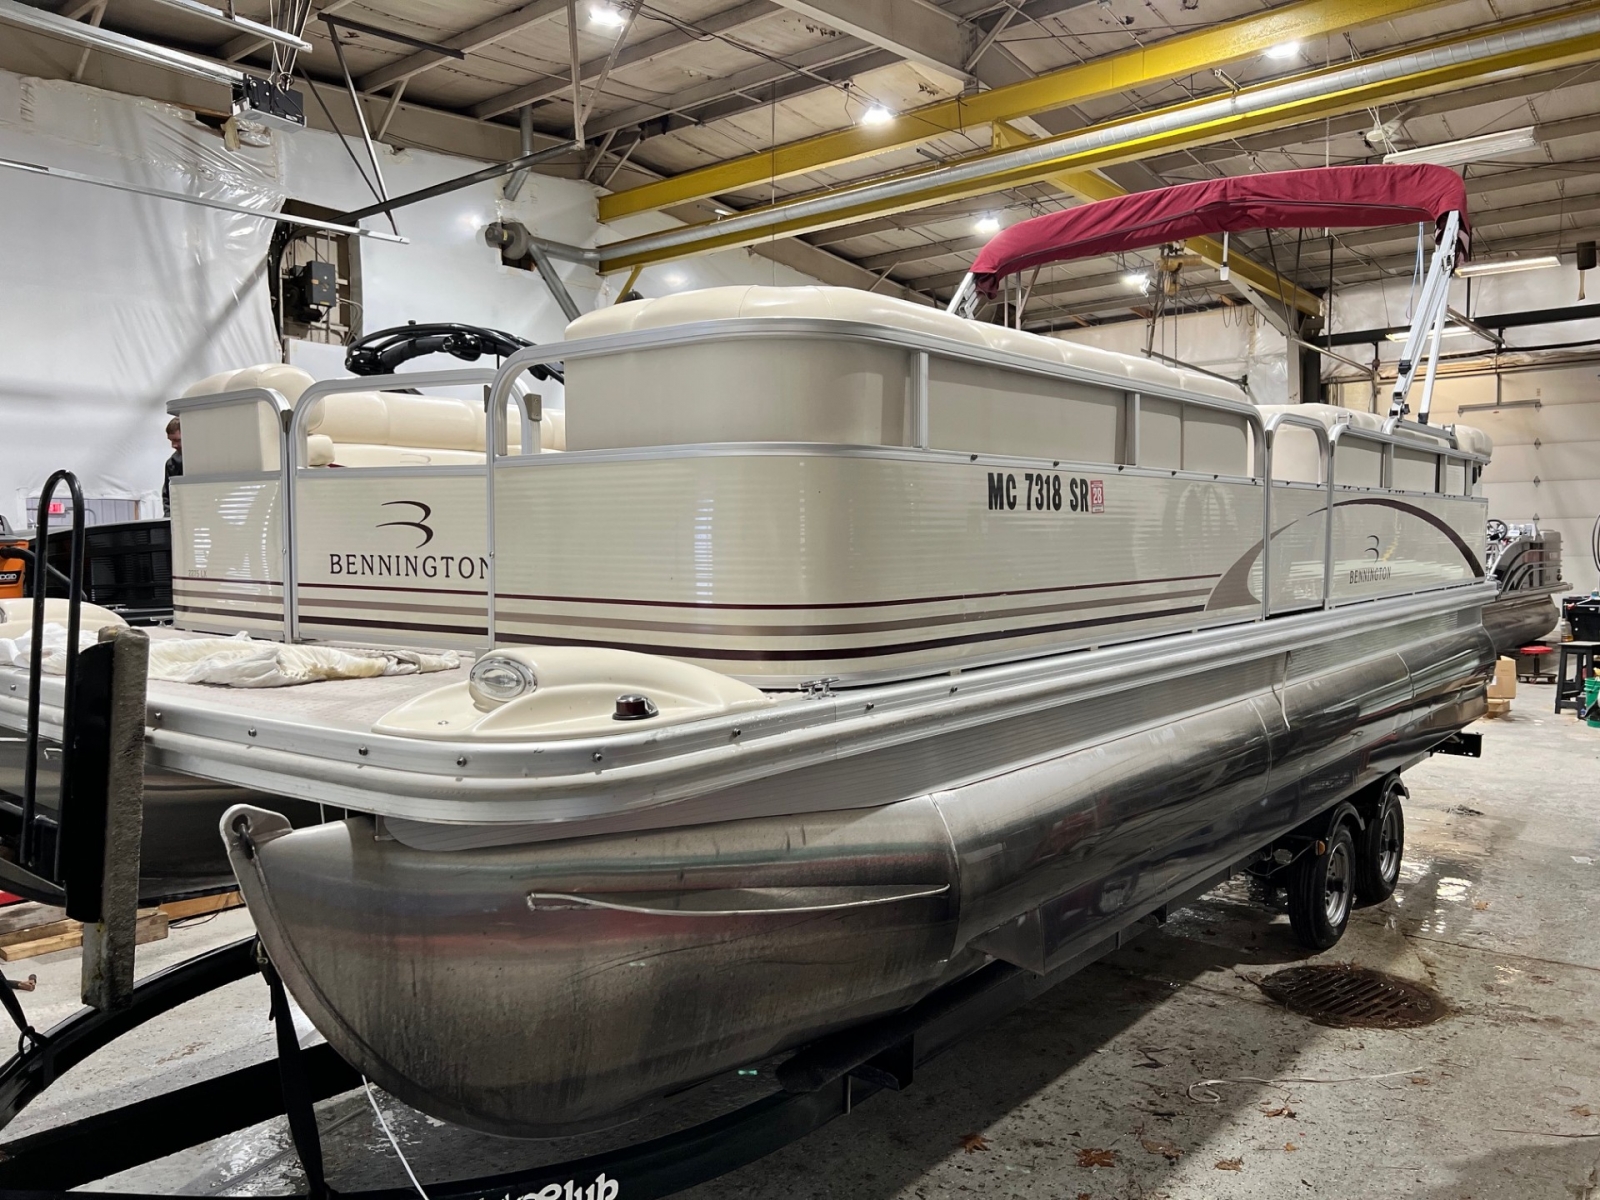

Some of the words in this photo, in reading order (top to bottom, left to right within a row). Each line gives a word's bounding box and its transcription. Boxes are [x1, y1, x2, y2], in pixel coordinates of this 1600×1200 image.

[988, 472, 1017, 510] MC
[1025, 473, 1062, 511] 7318
[1070, 478, 1089, 512] SR
[1349, 566, 1391, 584] BENNINGTON
